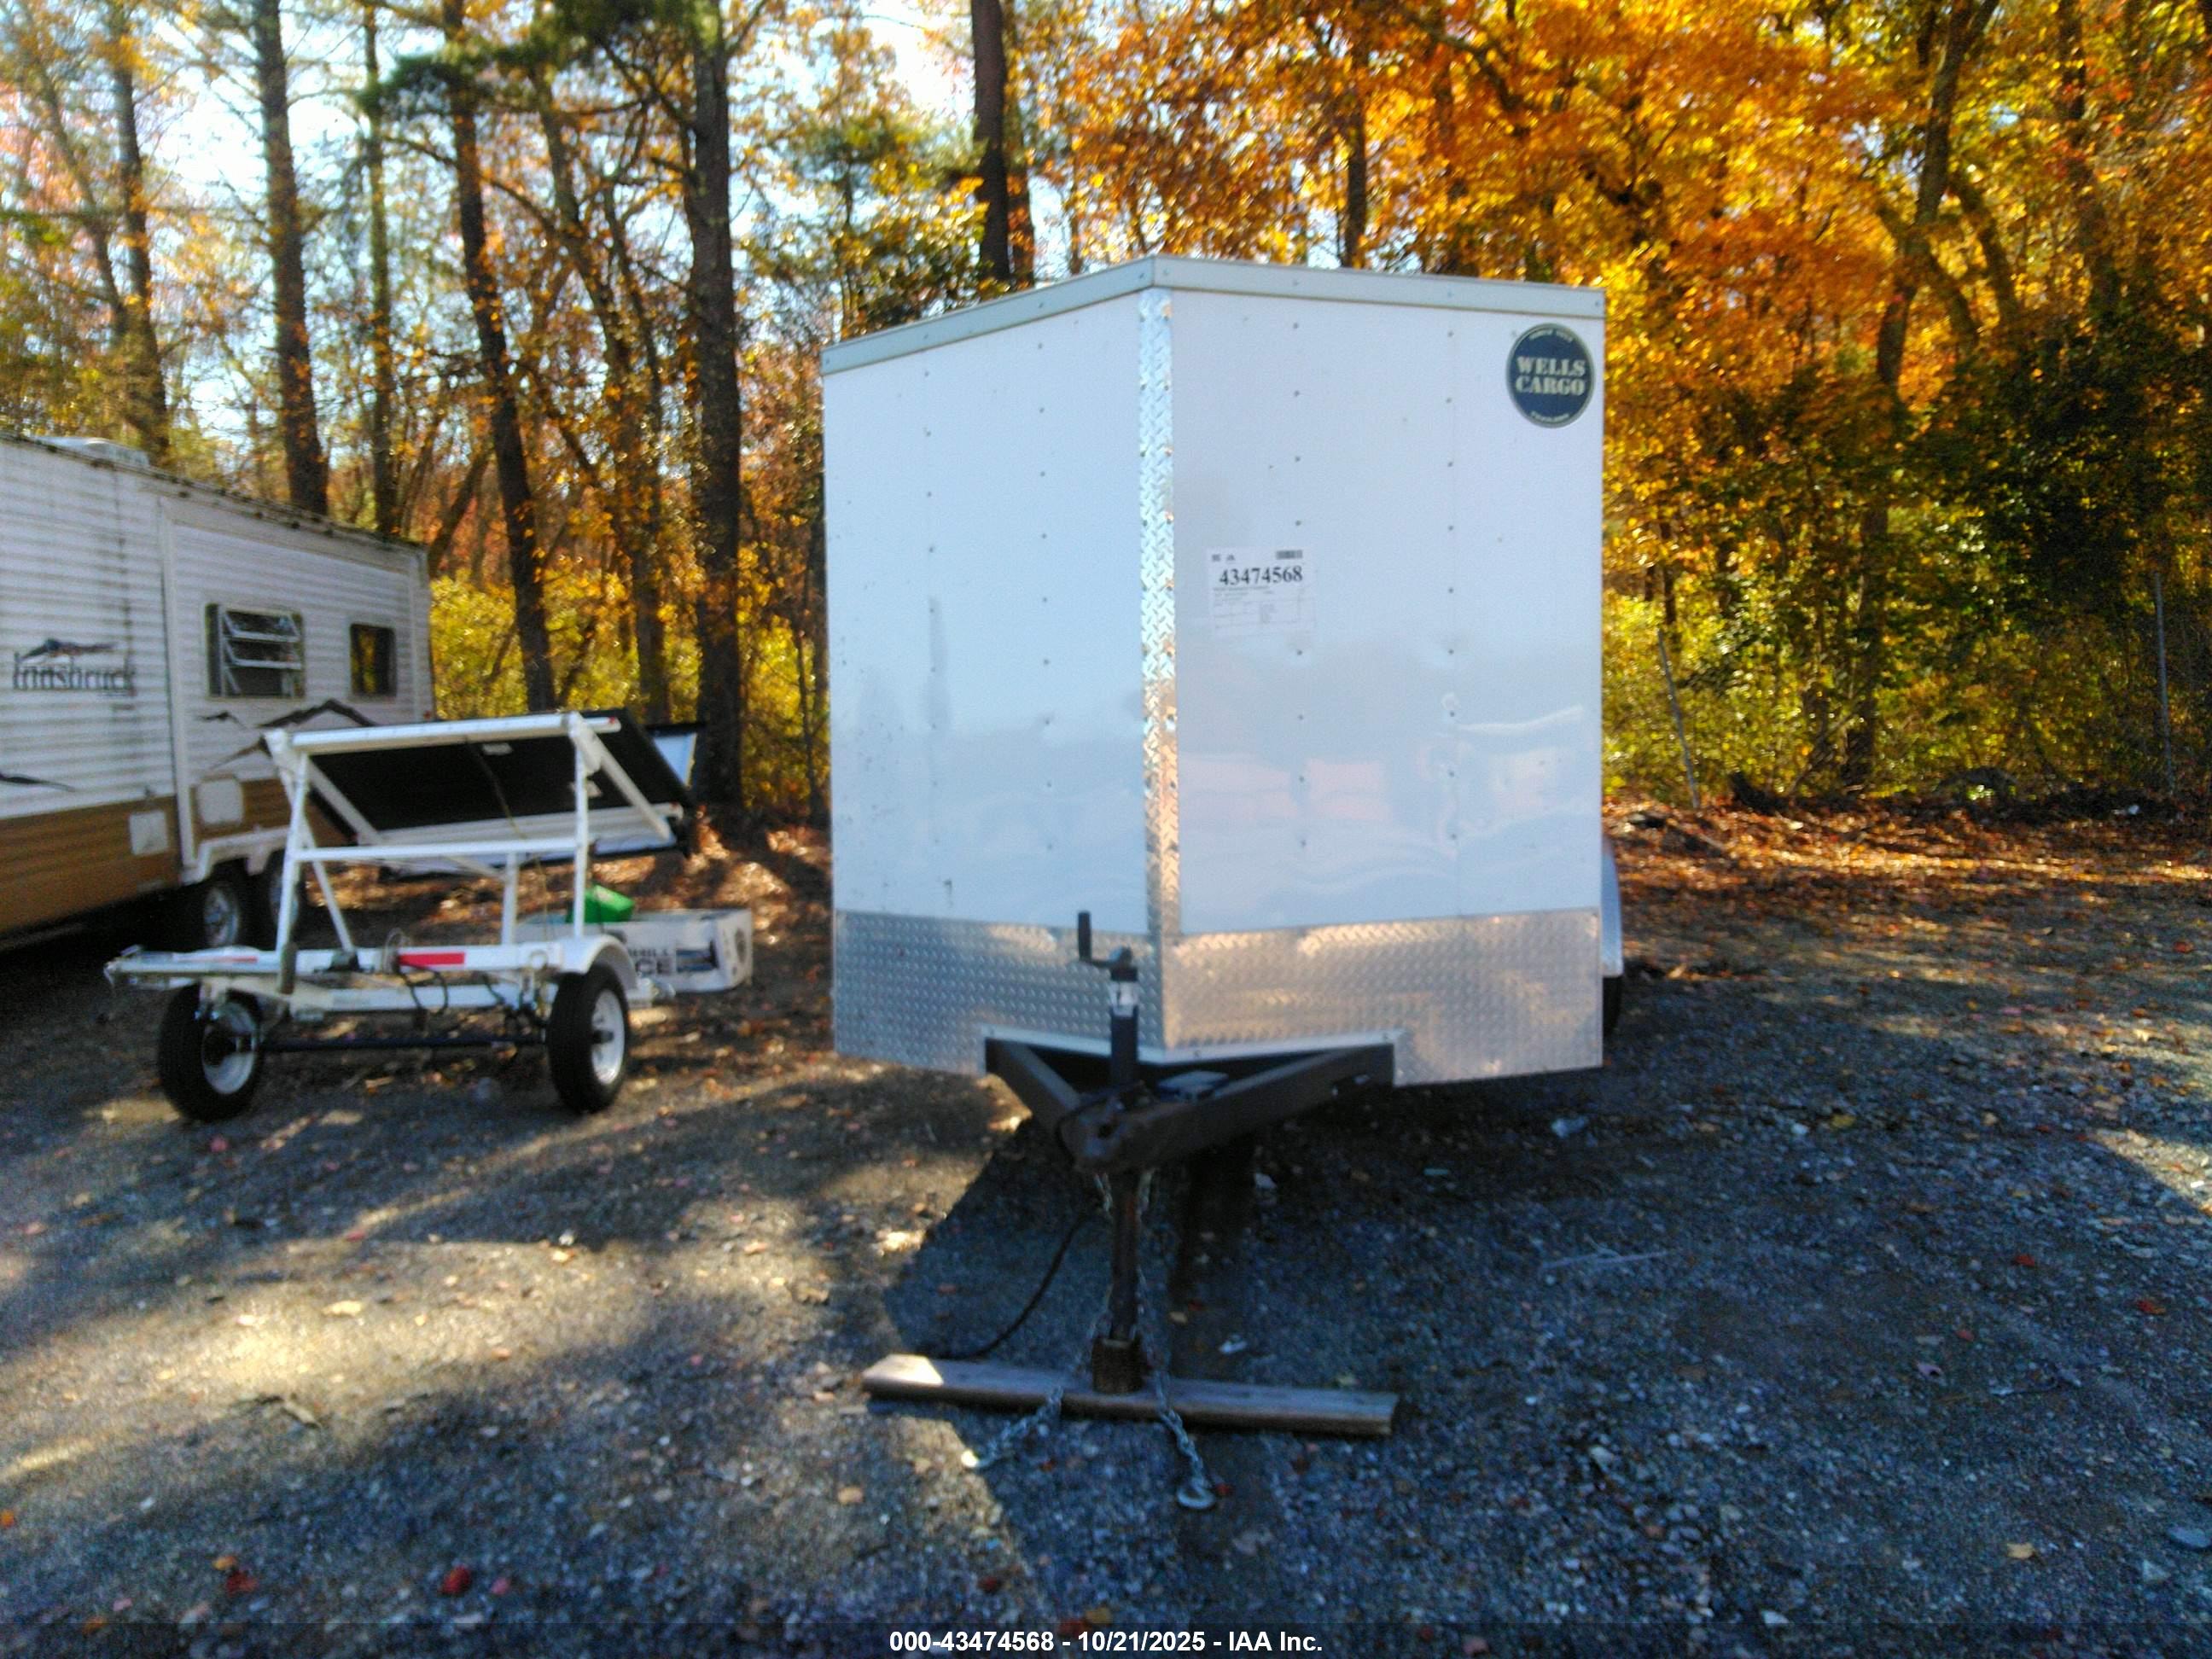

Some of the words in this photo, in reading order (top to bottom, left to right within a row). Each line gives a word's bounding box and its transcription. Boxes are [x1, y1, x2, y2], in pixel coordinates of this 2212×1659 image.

[1516, 356, 1586, 376] WELLS
[1515, 375, 1586, 396] CARGO
[1219, 565, 1303, 585] 43474568
